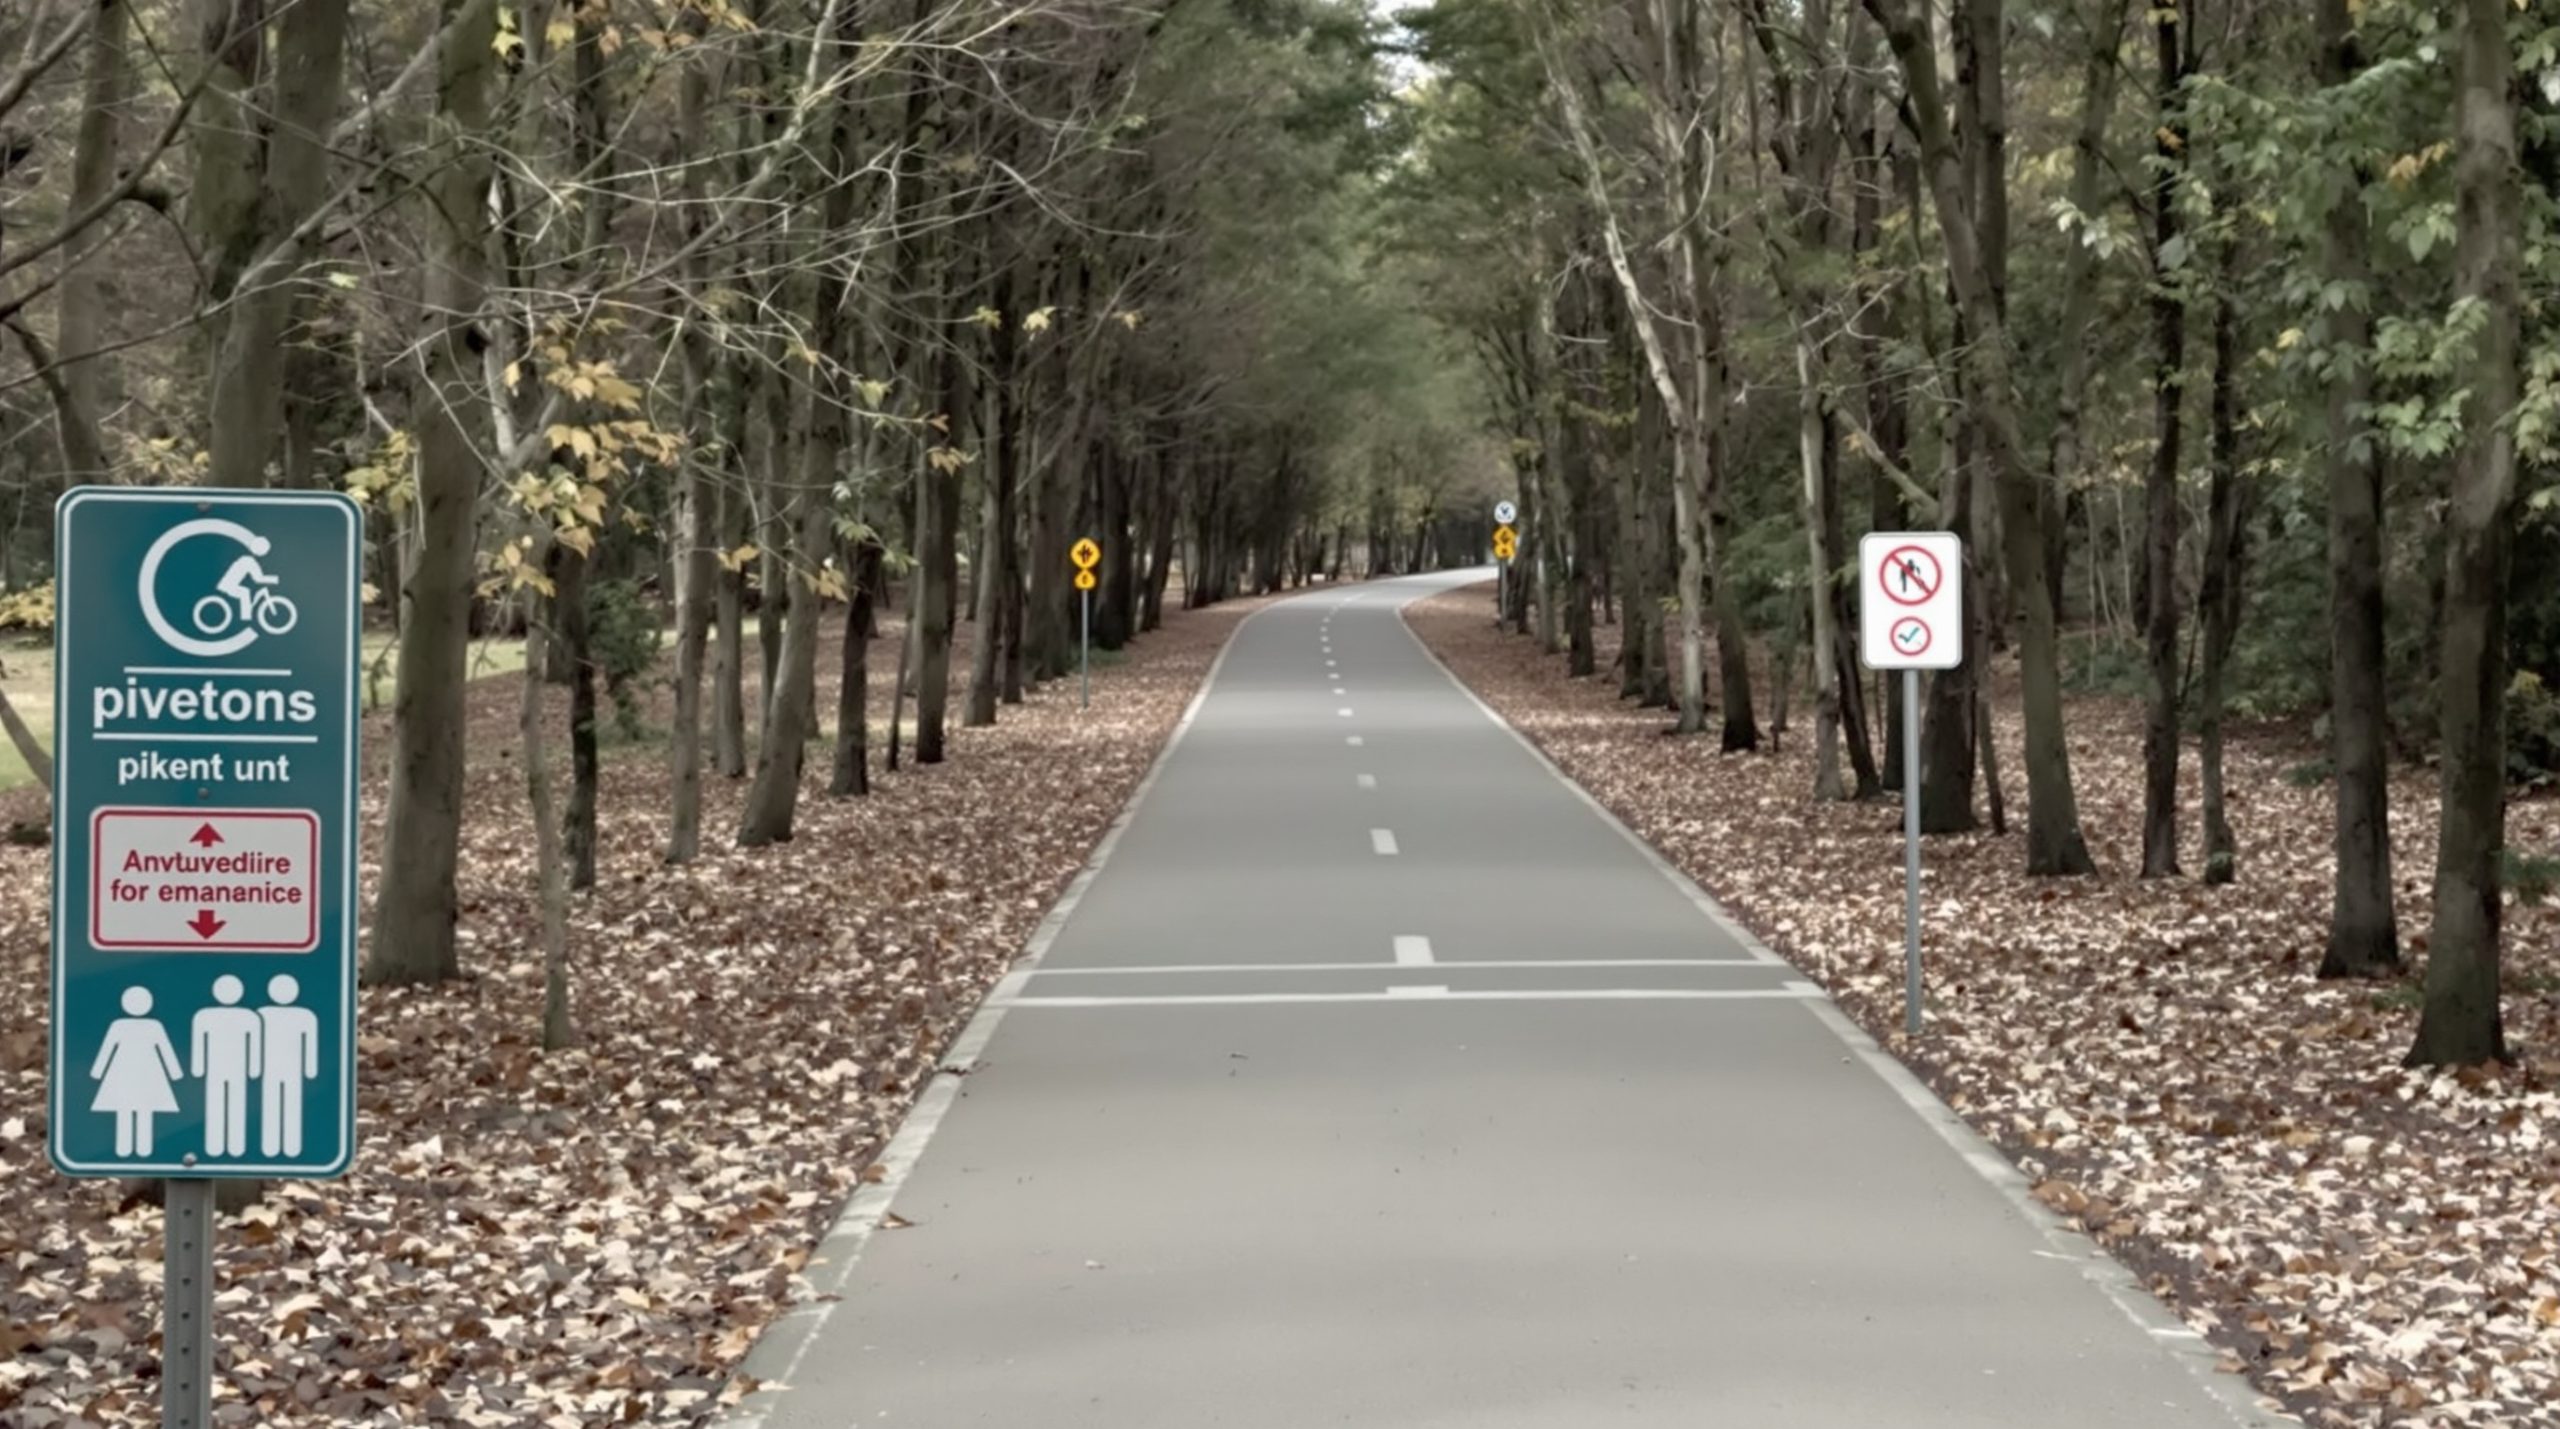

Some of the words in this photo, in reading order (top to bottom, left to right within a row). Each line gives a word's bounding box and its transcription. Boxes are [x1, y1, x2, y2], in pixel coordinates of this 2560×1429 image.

[94, 677, 316, 728] pivetons
[119, 751, 224, 785] pikent
[235, 754, 290, 781] unt
[111, 879, 149, 901] for
